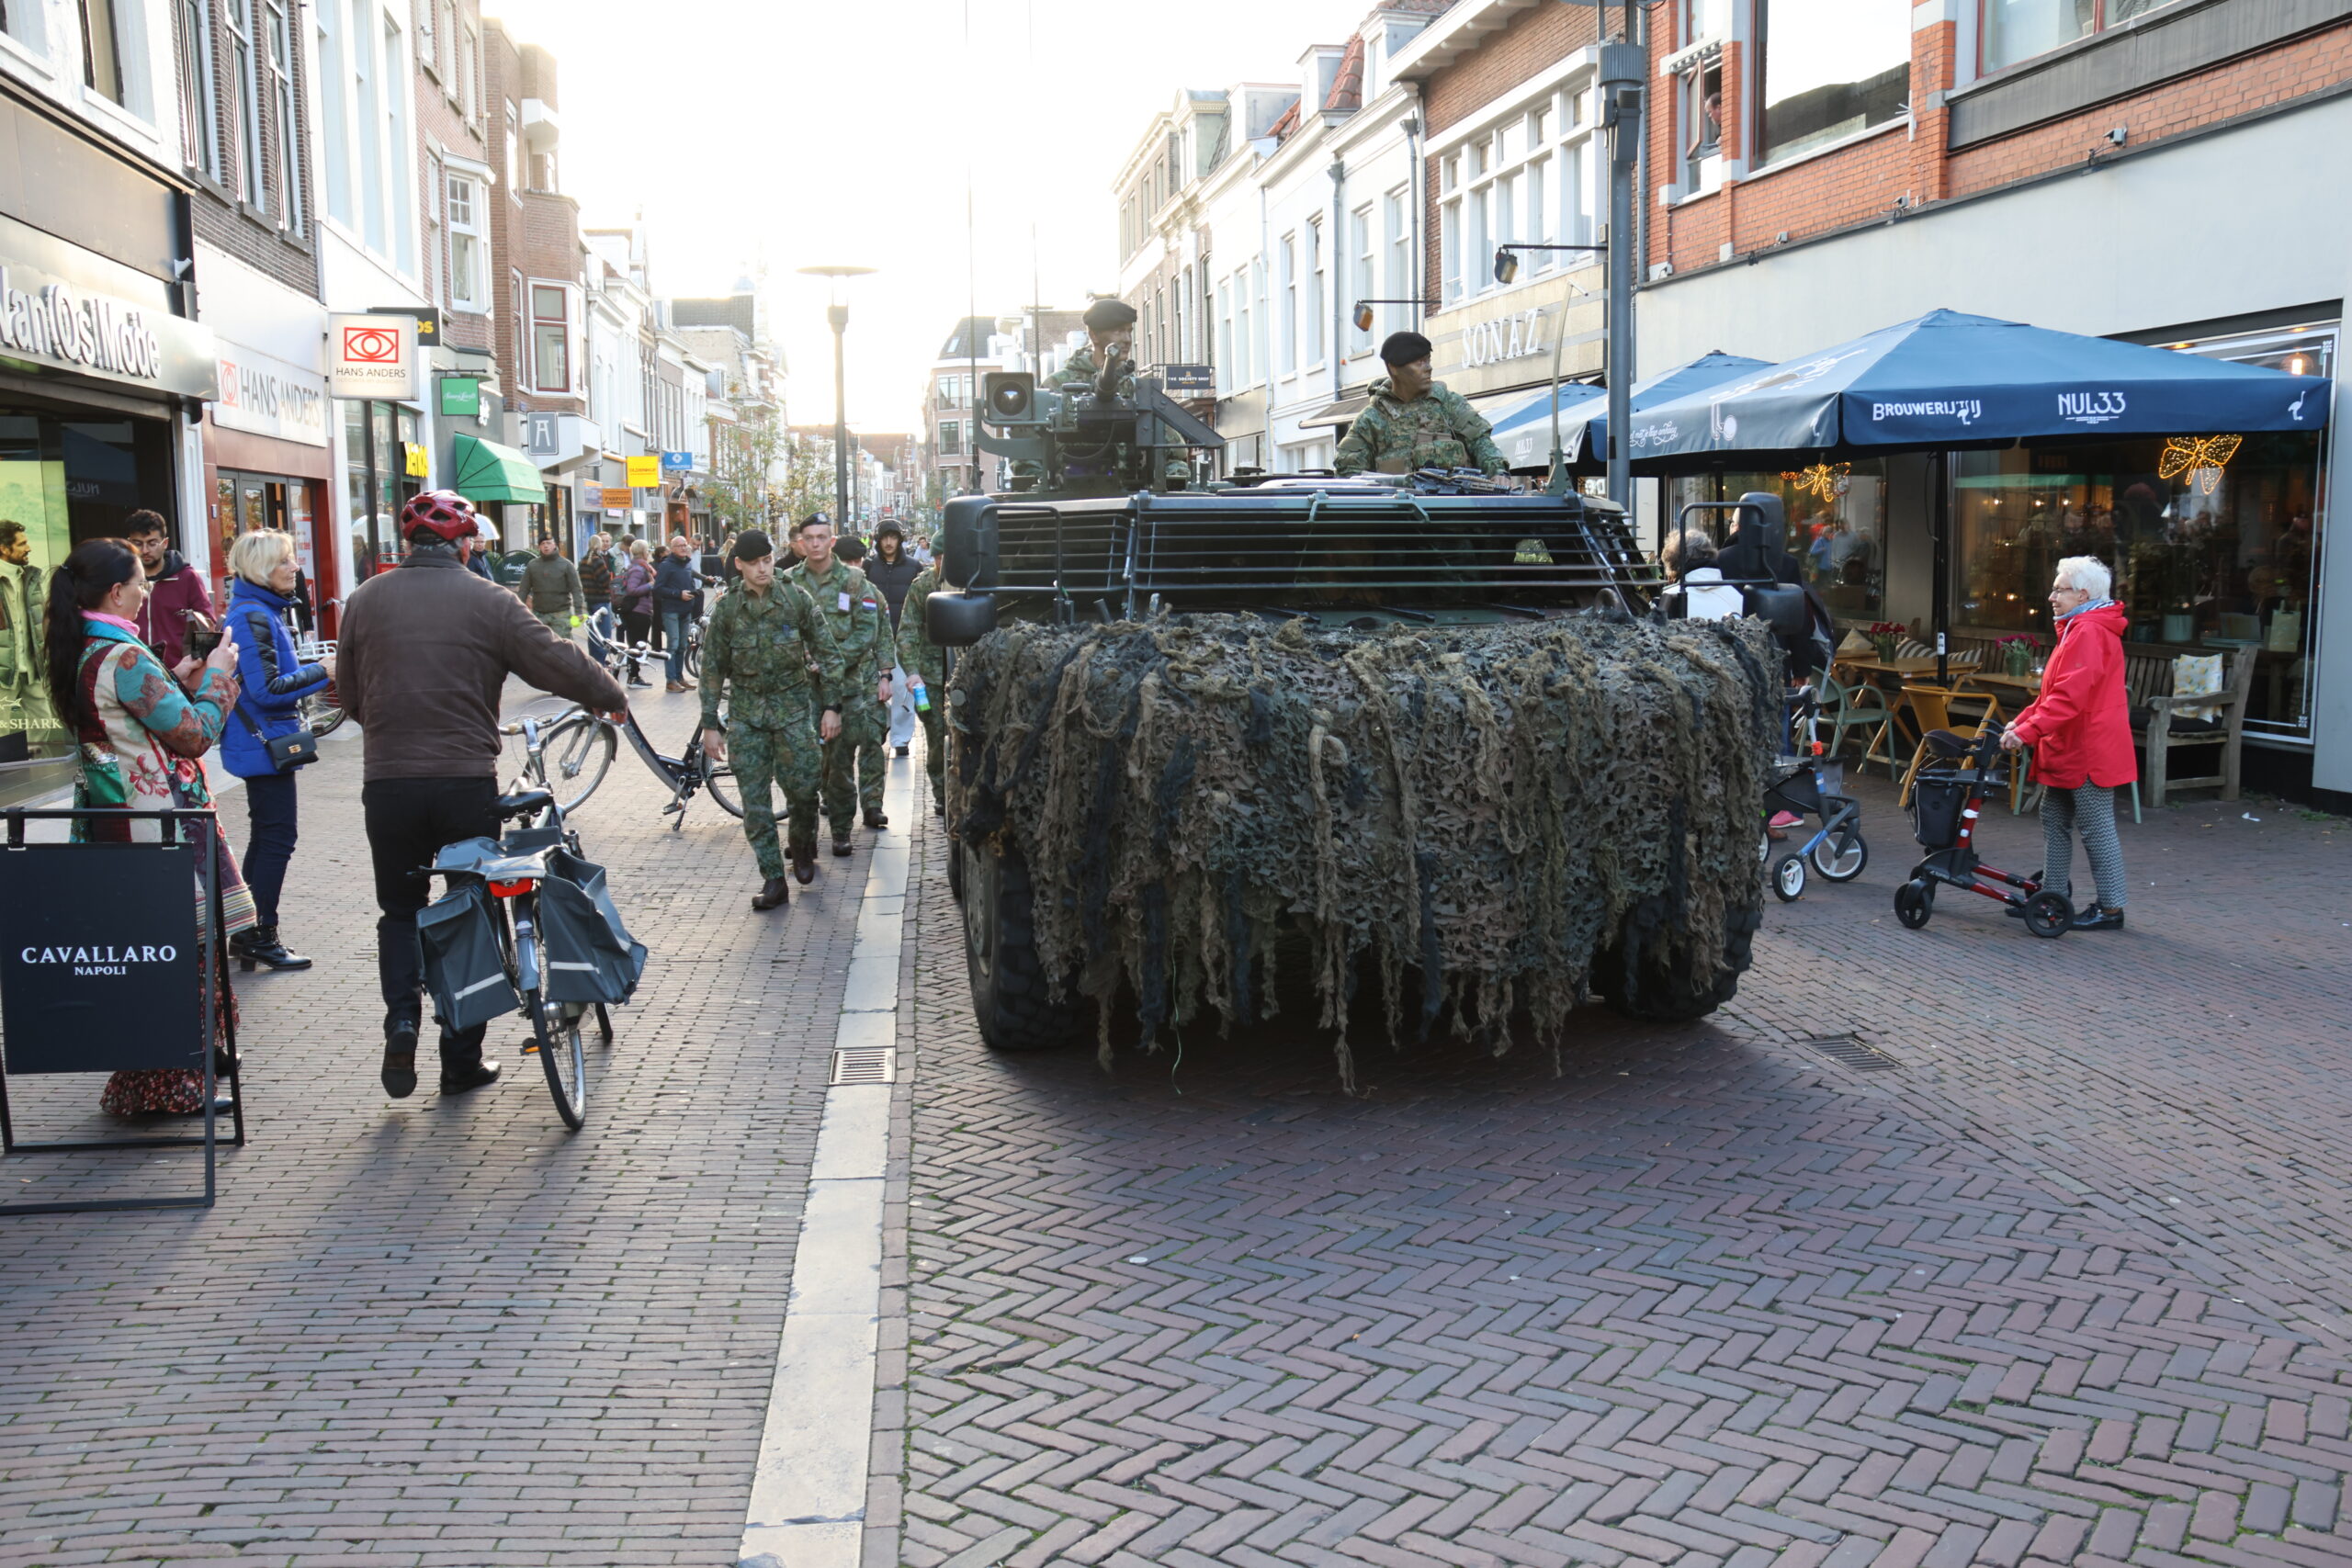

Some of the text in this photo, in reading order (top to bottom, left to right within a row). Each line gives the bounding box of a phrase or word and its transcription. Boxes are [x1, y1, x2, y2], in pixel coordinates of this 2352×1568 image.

[92, 298, 161, 379] Mode
[1462, 308, 1539, 369] SONAZ
[335, 367, 406, 378] HANS ANDERS
[240, 367, 321, 429] HANS ANDERS
[2057, 391, 2126, 415] NUL33
[1872, 400, 1956, 421] BROUWERIJ
[9, 718, 63, 729] SHARK
[21, 945, 177, 964] CAVALLARO
[74, 966, 127, 976] NAPOLI
